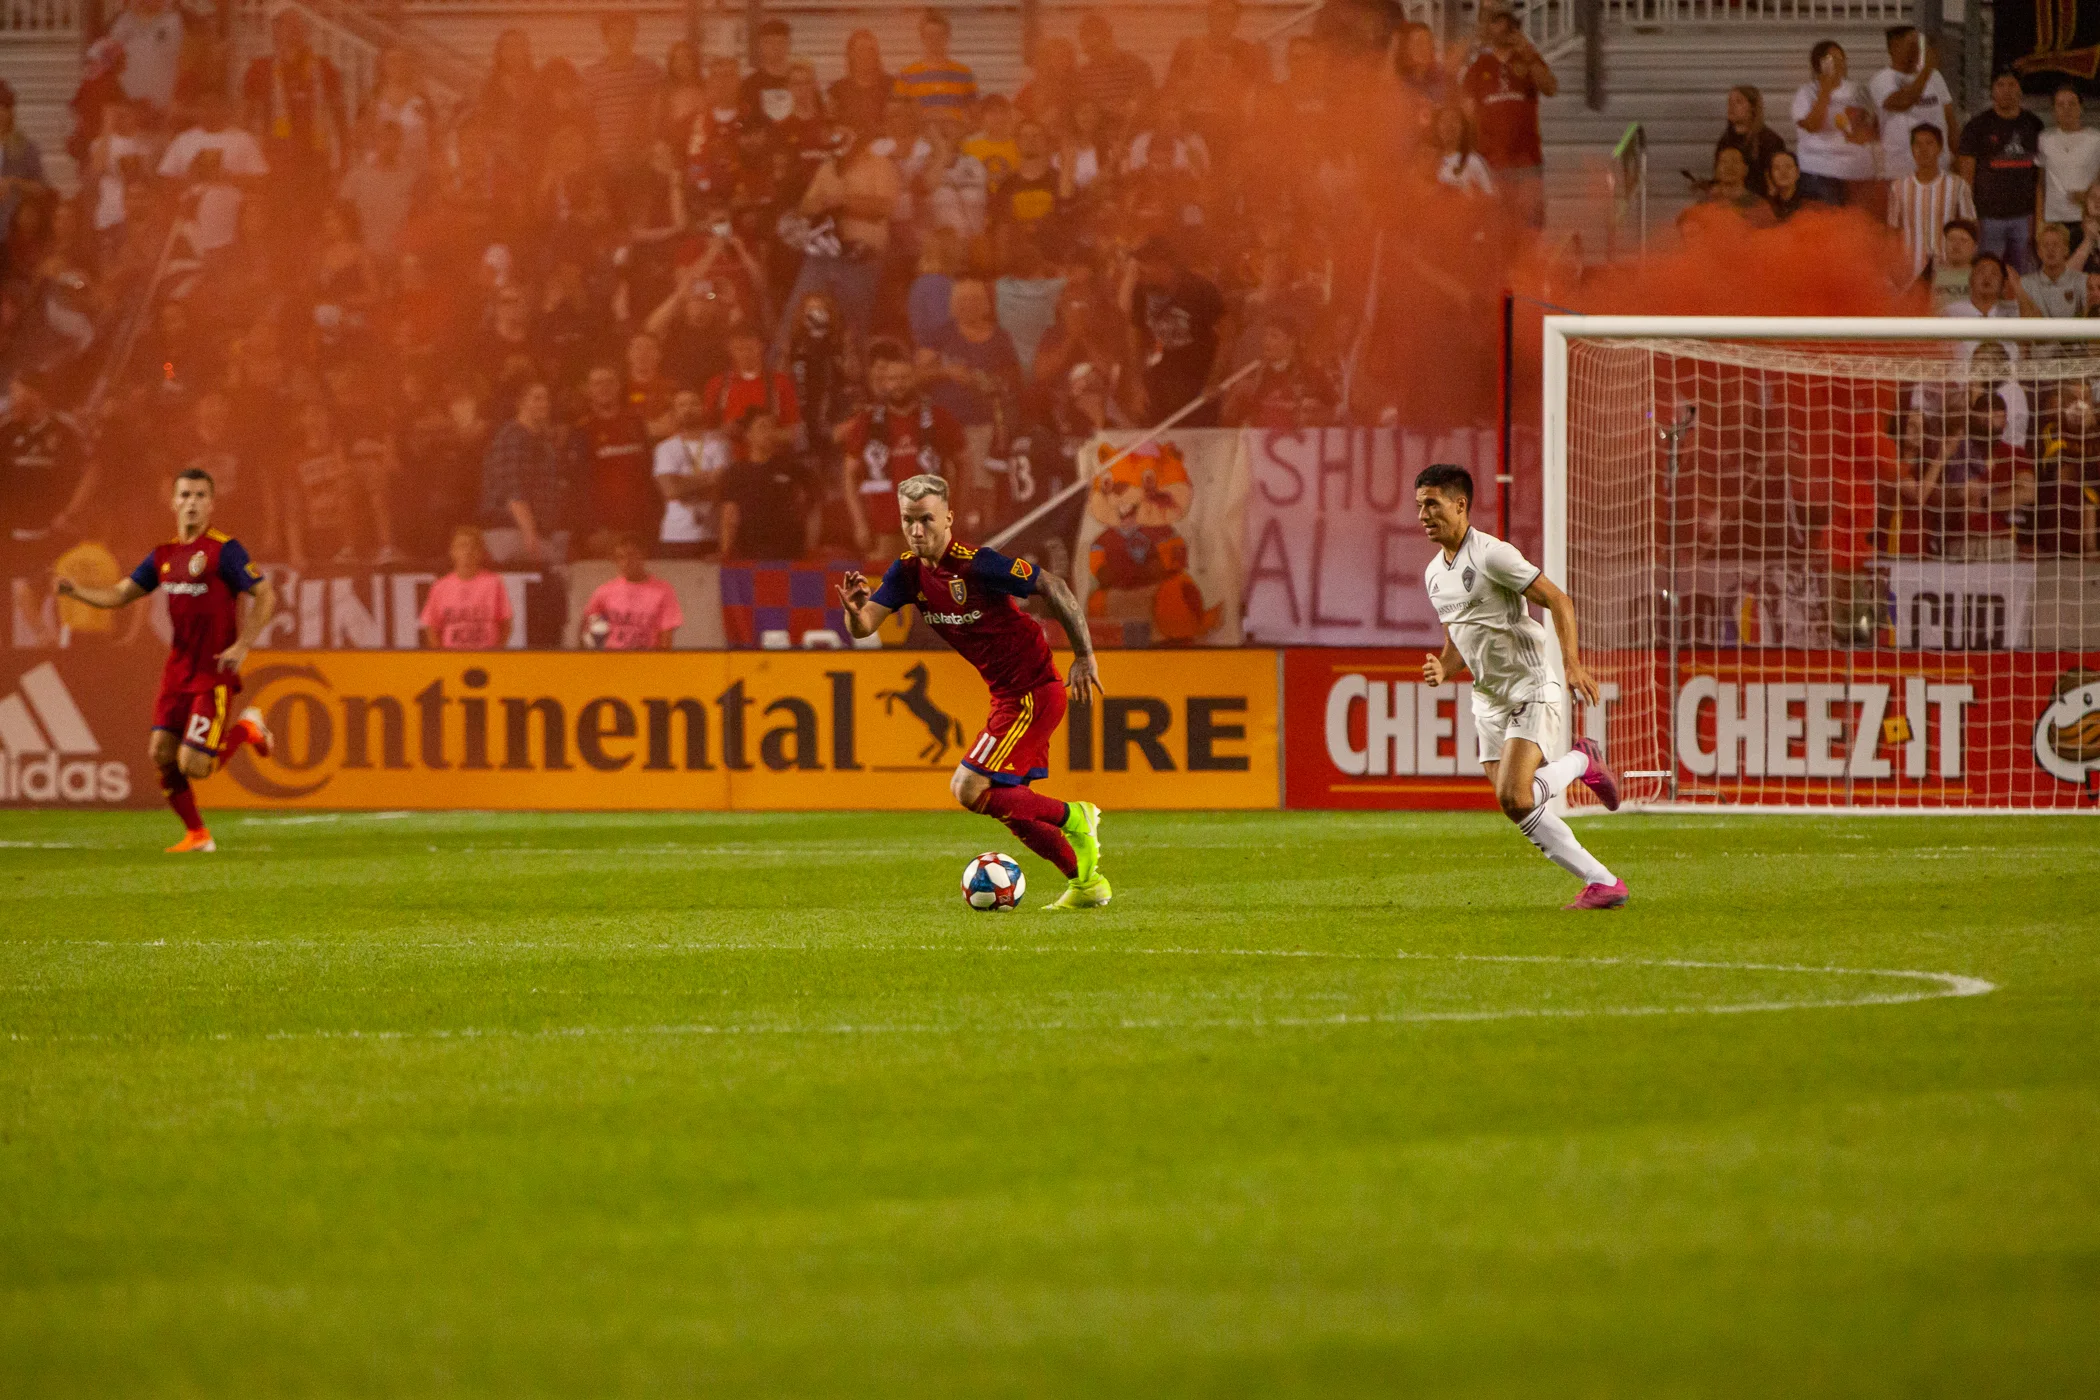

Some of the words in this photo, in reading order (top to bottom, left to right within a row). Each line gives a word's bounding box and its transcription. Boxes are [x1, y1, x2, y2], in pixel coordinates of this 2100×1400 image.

[186, 712, 211, 744] 12
[226, 663, 865, 799] Continental
[1067, 694, 1249, 772] IRE
[969, 731, 997, 764] 11
[0, 750, 132, 802] idas
